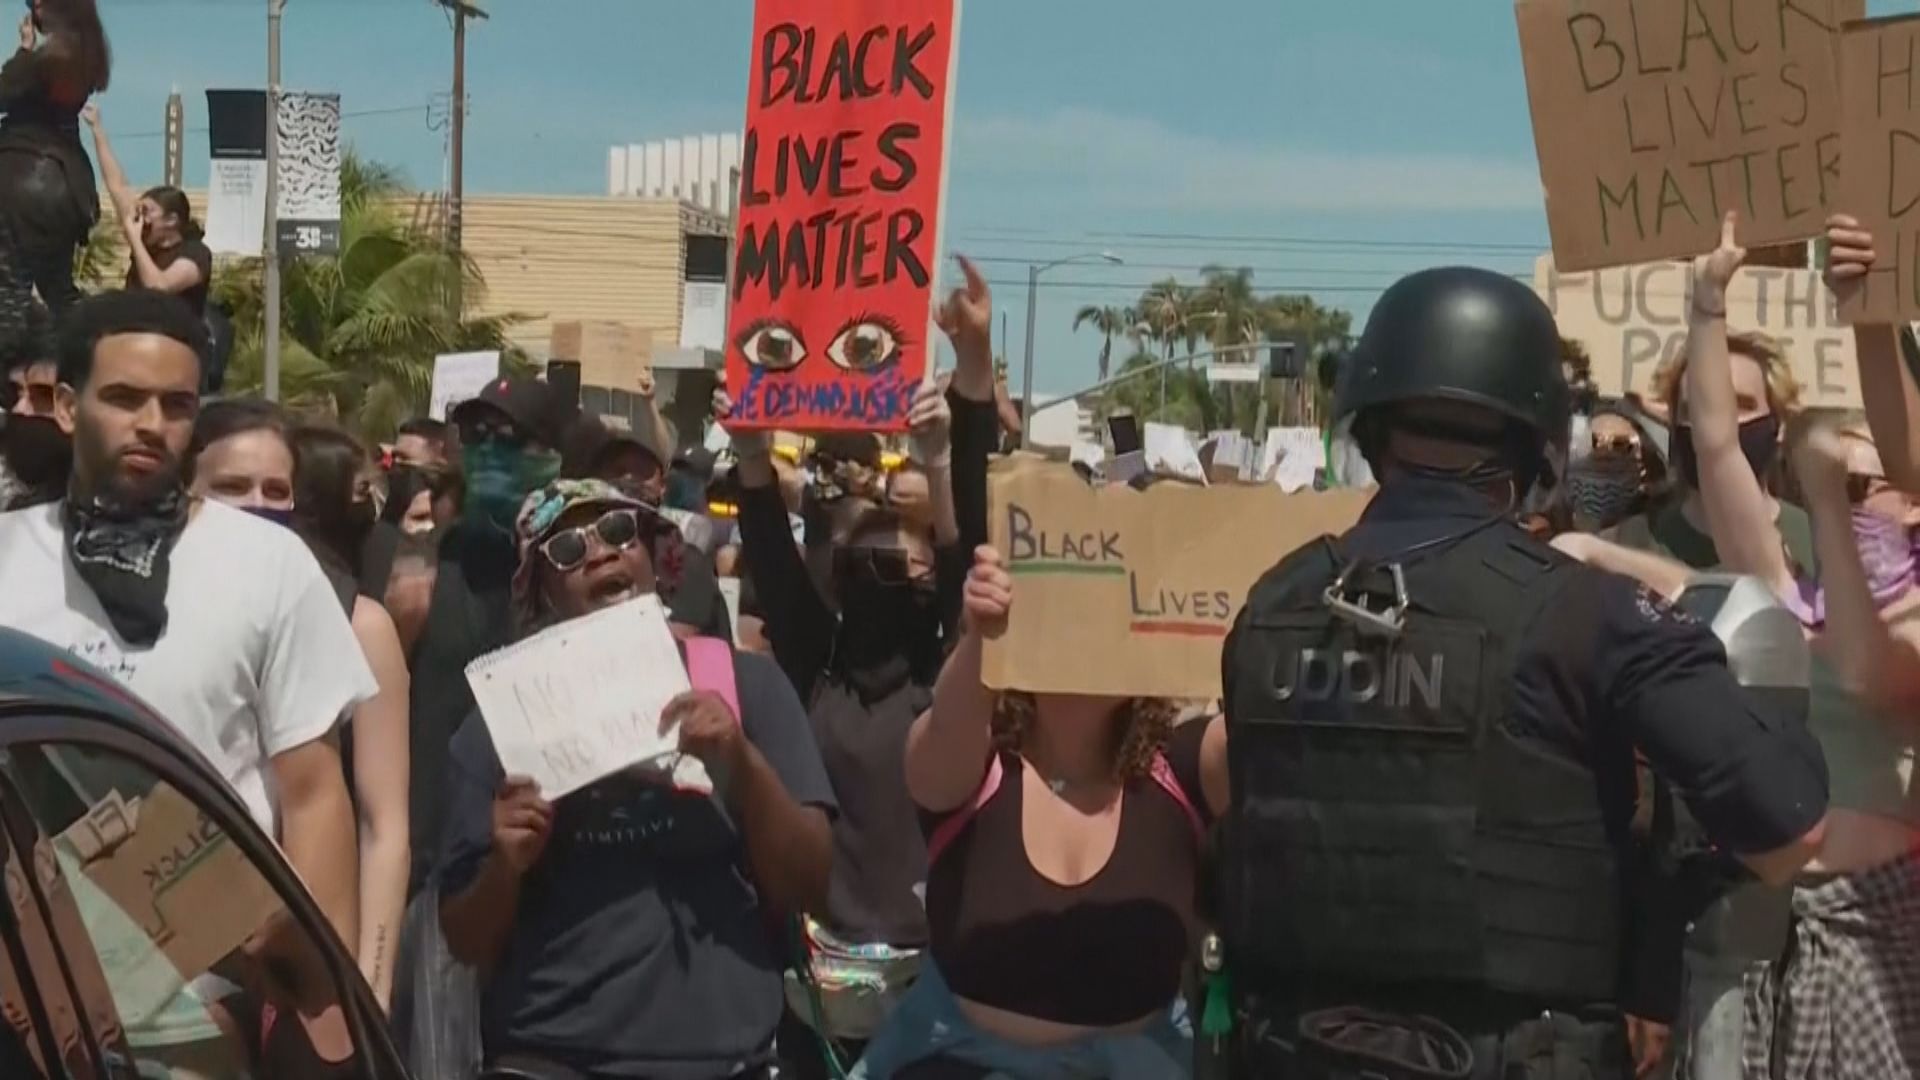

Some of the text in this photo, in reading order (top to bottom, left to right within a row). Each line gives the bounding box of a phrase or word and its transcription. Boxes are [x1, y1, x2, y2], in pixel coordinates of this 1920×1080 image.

[760, 22, 936, 108] BLACK
[1622, 62, 1809, 153] LIVES
[740, 122, 921, 207] LIVES
[1596, 133, 1841, 247] MATTER
[733, 206, 930, 303] MATTER
[1550, 262, 1694, 326] FUC
[1008, 503, 1124, 560] BLACK
[1130, 570, 1231, 619] LIVES
[1266, 648, 1444, 708] UDDIN
